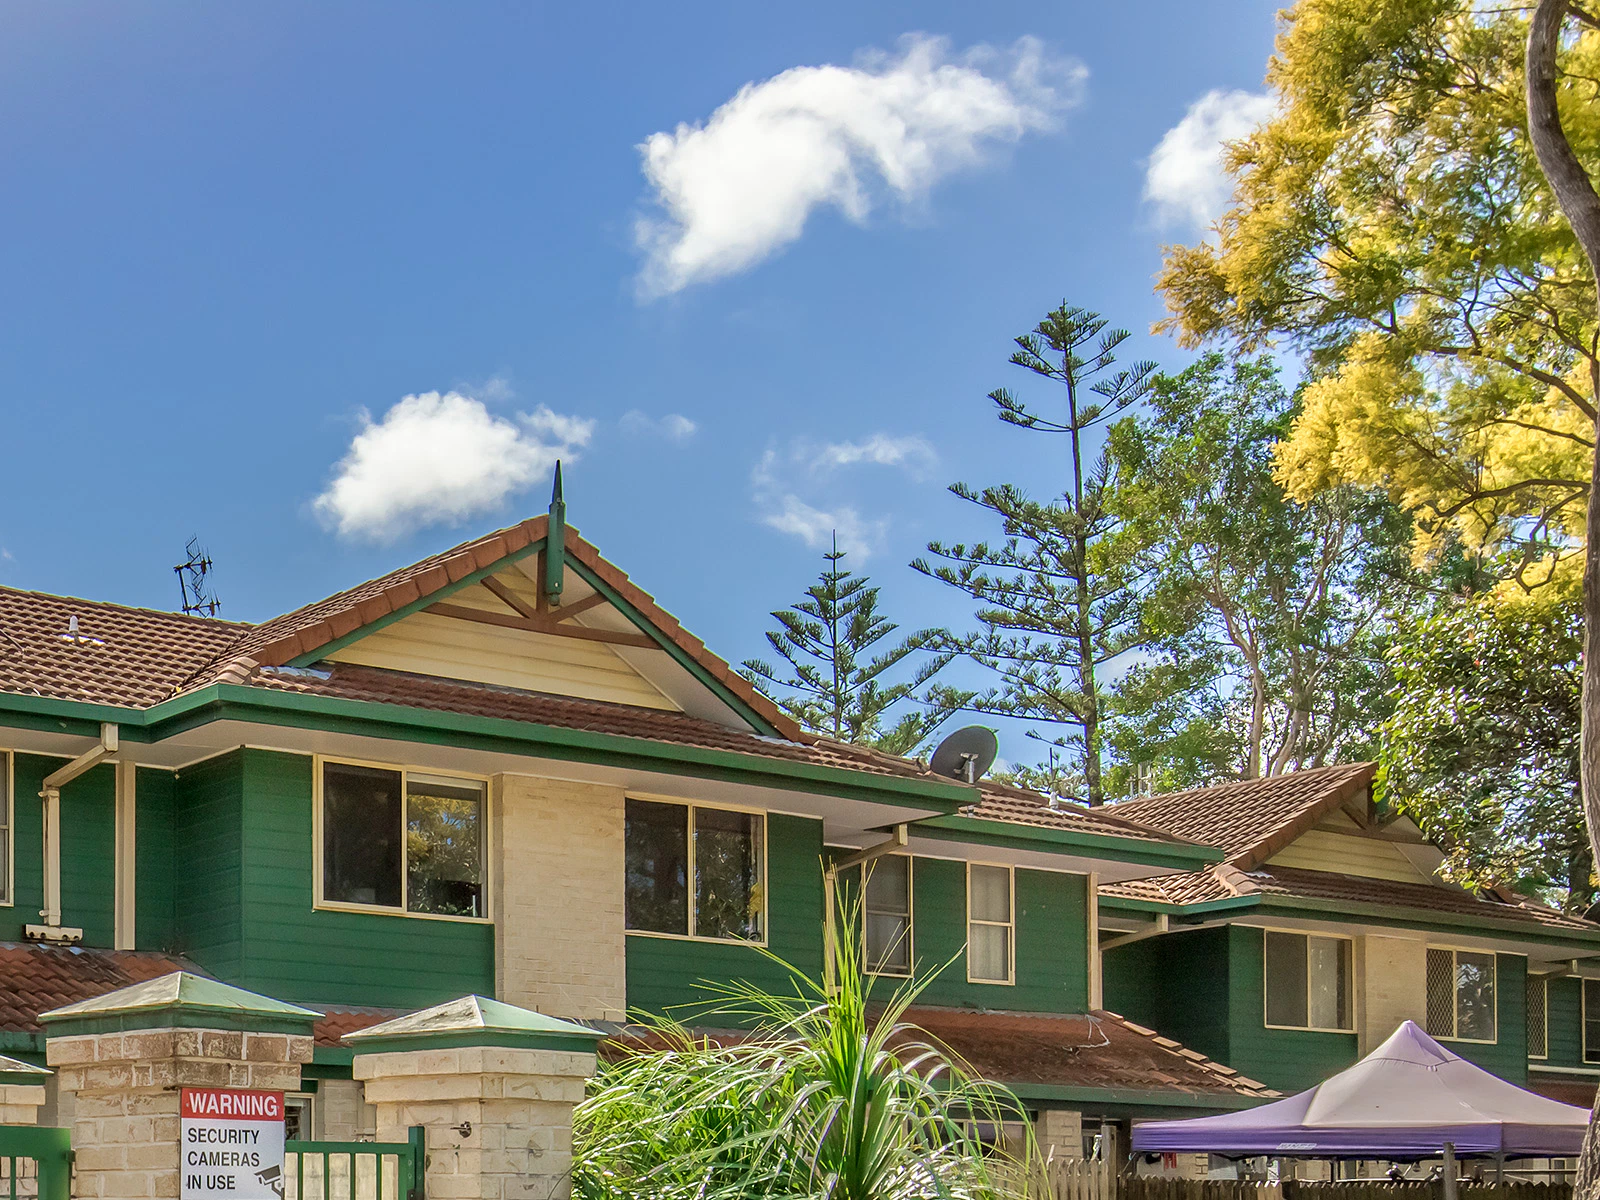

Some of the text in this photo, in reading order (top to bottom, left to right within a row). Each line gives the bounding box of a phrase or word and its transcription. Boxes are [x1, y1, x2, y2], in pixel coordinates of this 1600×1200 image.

[189, 1092, 277, 1117] WARNING
[188, 1127, 260, 1145] SECURITY
[188, 1151, 260, 1167] CAMERAS
[187, 1175, 235, 1190] IN USE
